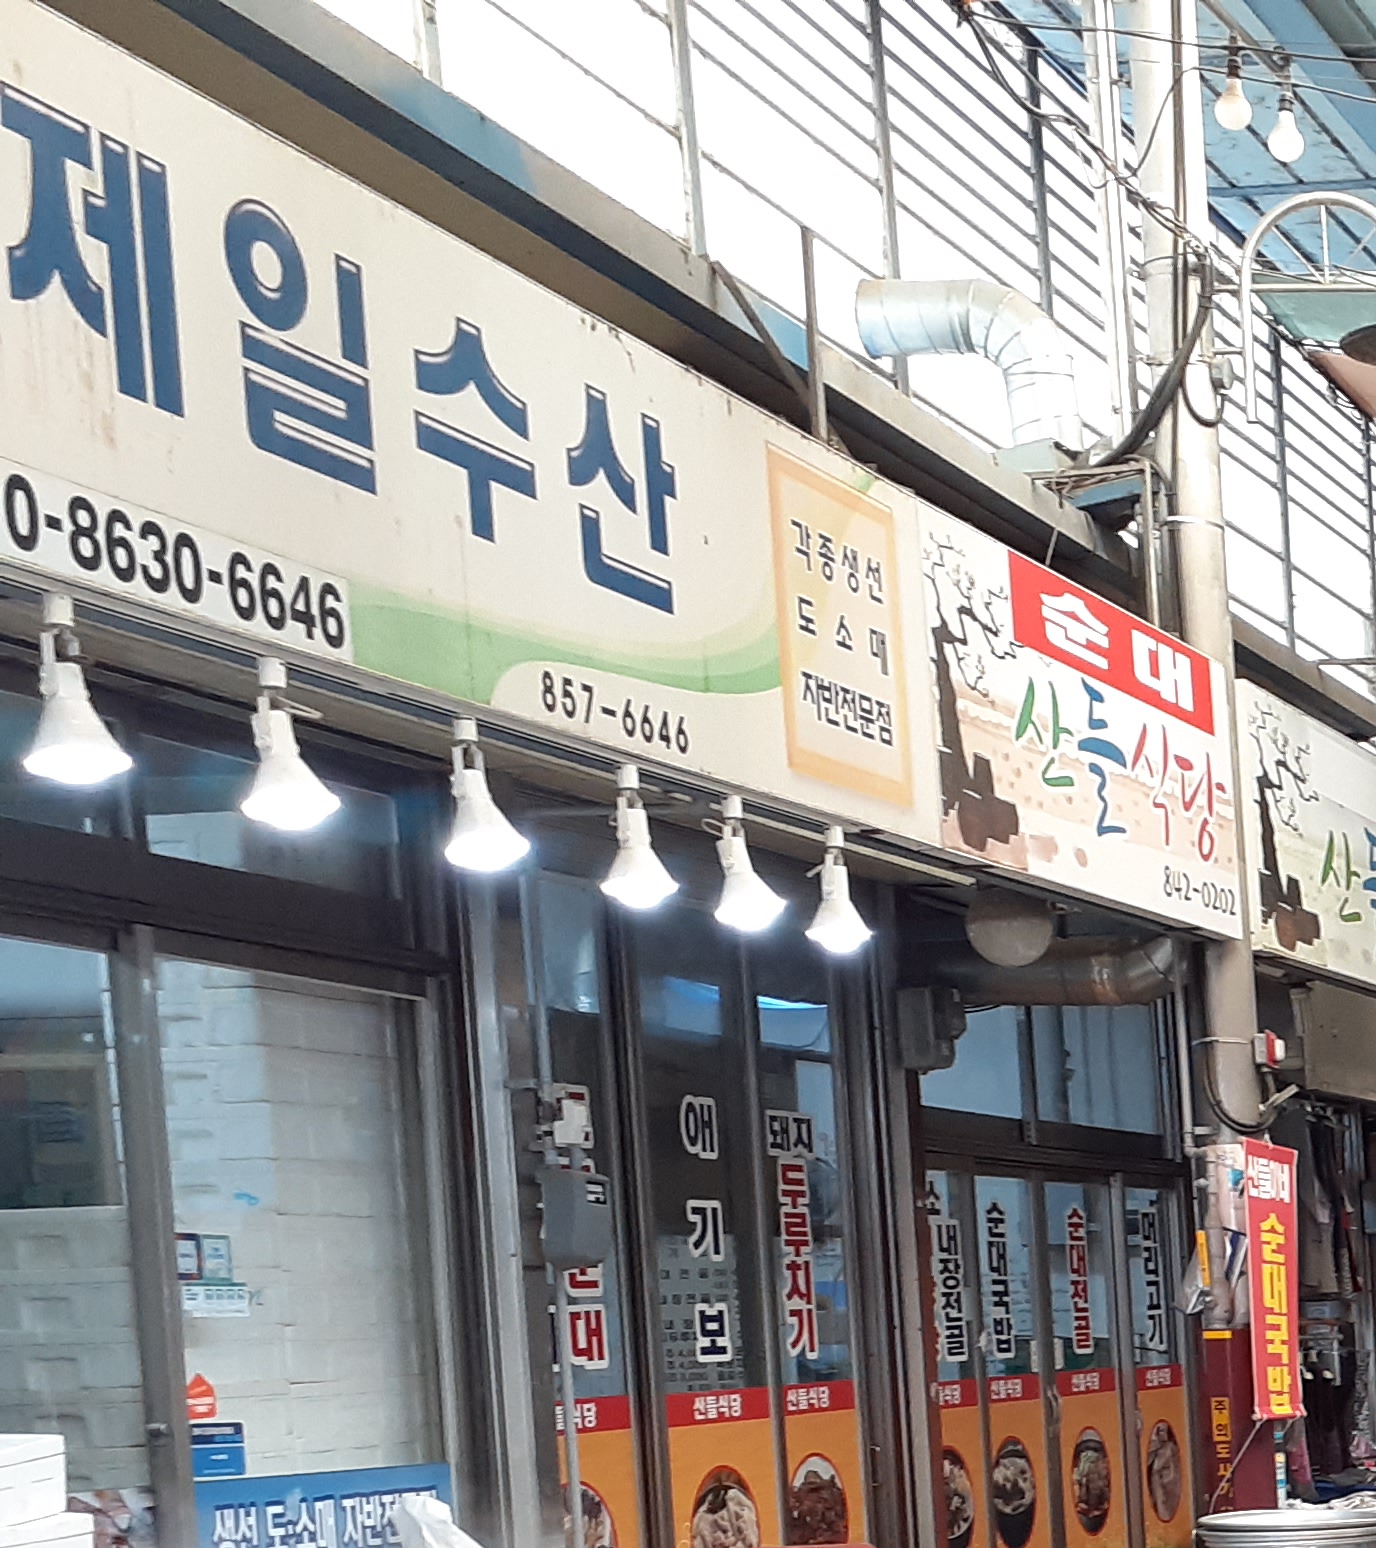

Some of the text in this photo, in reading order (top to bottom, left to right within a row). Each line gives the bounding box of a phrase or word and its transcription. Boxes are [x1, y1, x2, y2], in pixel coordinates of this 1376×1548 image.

[0, 82, 678, 616] 제일수산
[790, 518, 884, 605] 각종생선
[801, 670, 894, 748] 자반전문점
[1040, 589, 1195, 712] 순대
[540, 669, 690, 756] 857-6646
[1015, 675, 1227, 862] 산들식당
[1163, 864, 1237, 917] 842-0202
[765, 1109, 815, 1158] 돼지
[777, 1160, 819, 1359] 두루치기
[935, 1222, 966, 1358] 내장전골
[985, 1201, 1014, 1354] 순대국밥
[1066, 1205, 1093, 1351] 순대전골
[1259, 1212, 1294, 1415] 순대국밥
[693, 1394, 743, 1420] 산들식당
[786, 1386, 830, 1412] 산들식당
